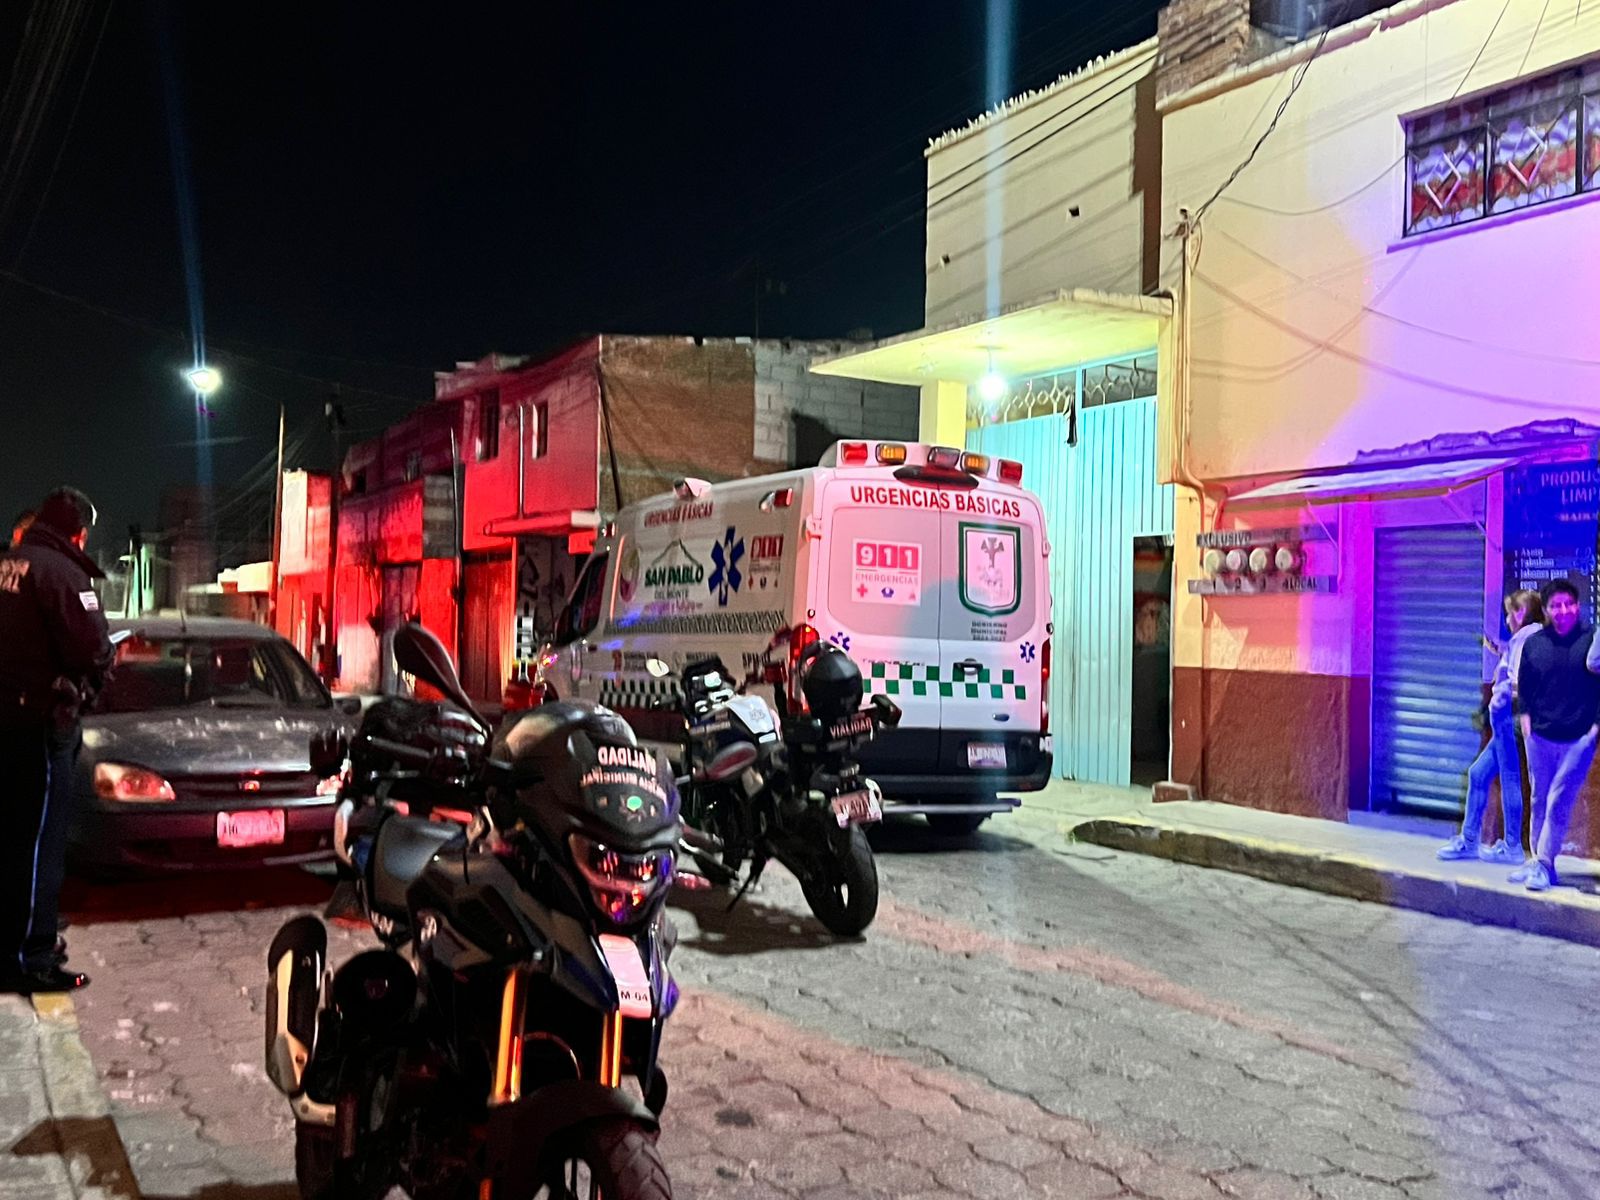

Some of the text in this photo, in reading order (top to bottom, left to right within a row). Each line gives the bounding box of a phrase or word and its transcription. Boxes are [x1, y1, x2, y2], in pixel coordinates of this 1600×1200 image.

[850, 486, 950, 510] URGENCIAS
[859, 545, 914, 569] 911
[644, 564, 704, 587] SAN PABLO
[855, 573, 918, 585] EMERGENCIAS
